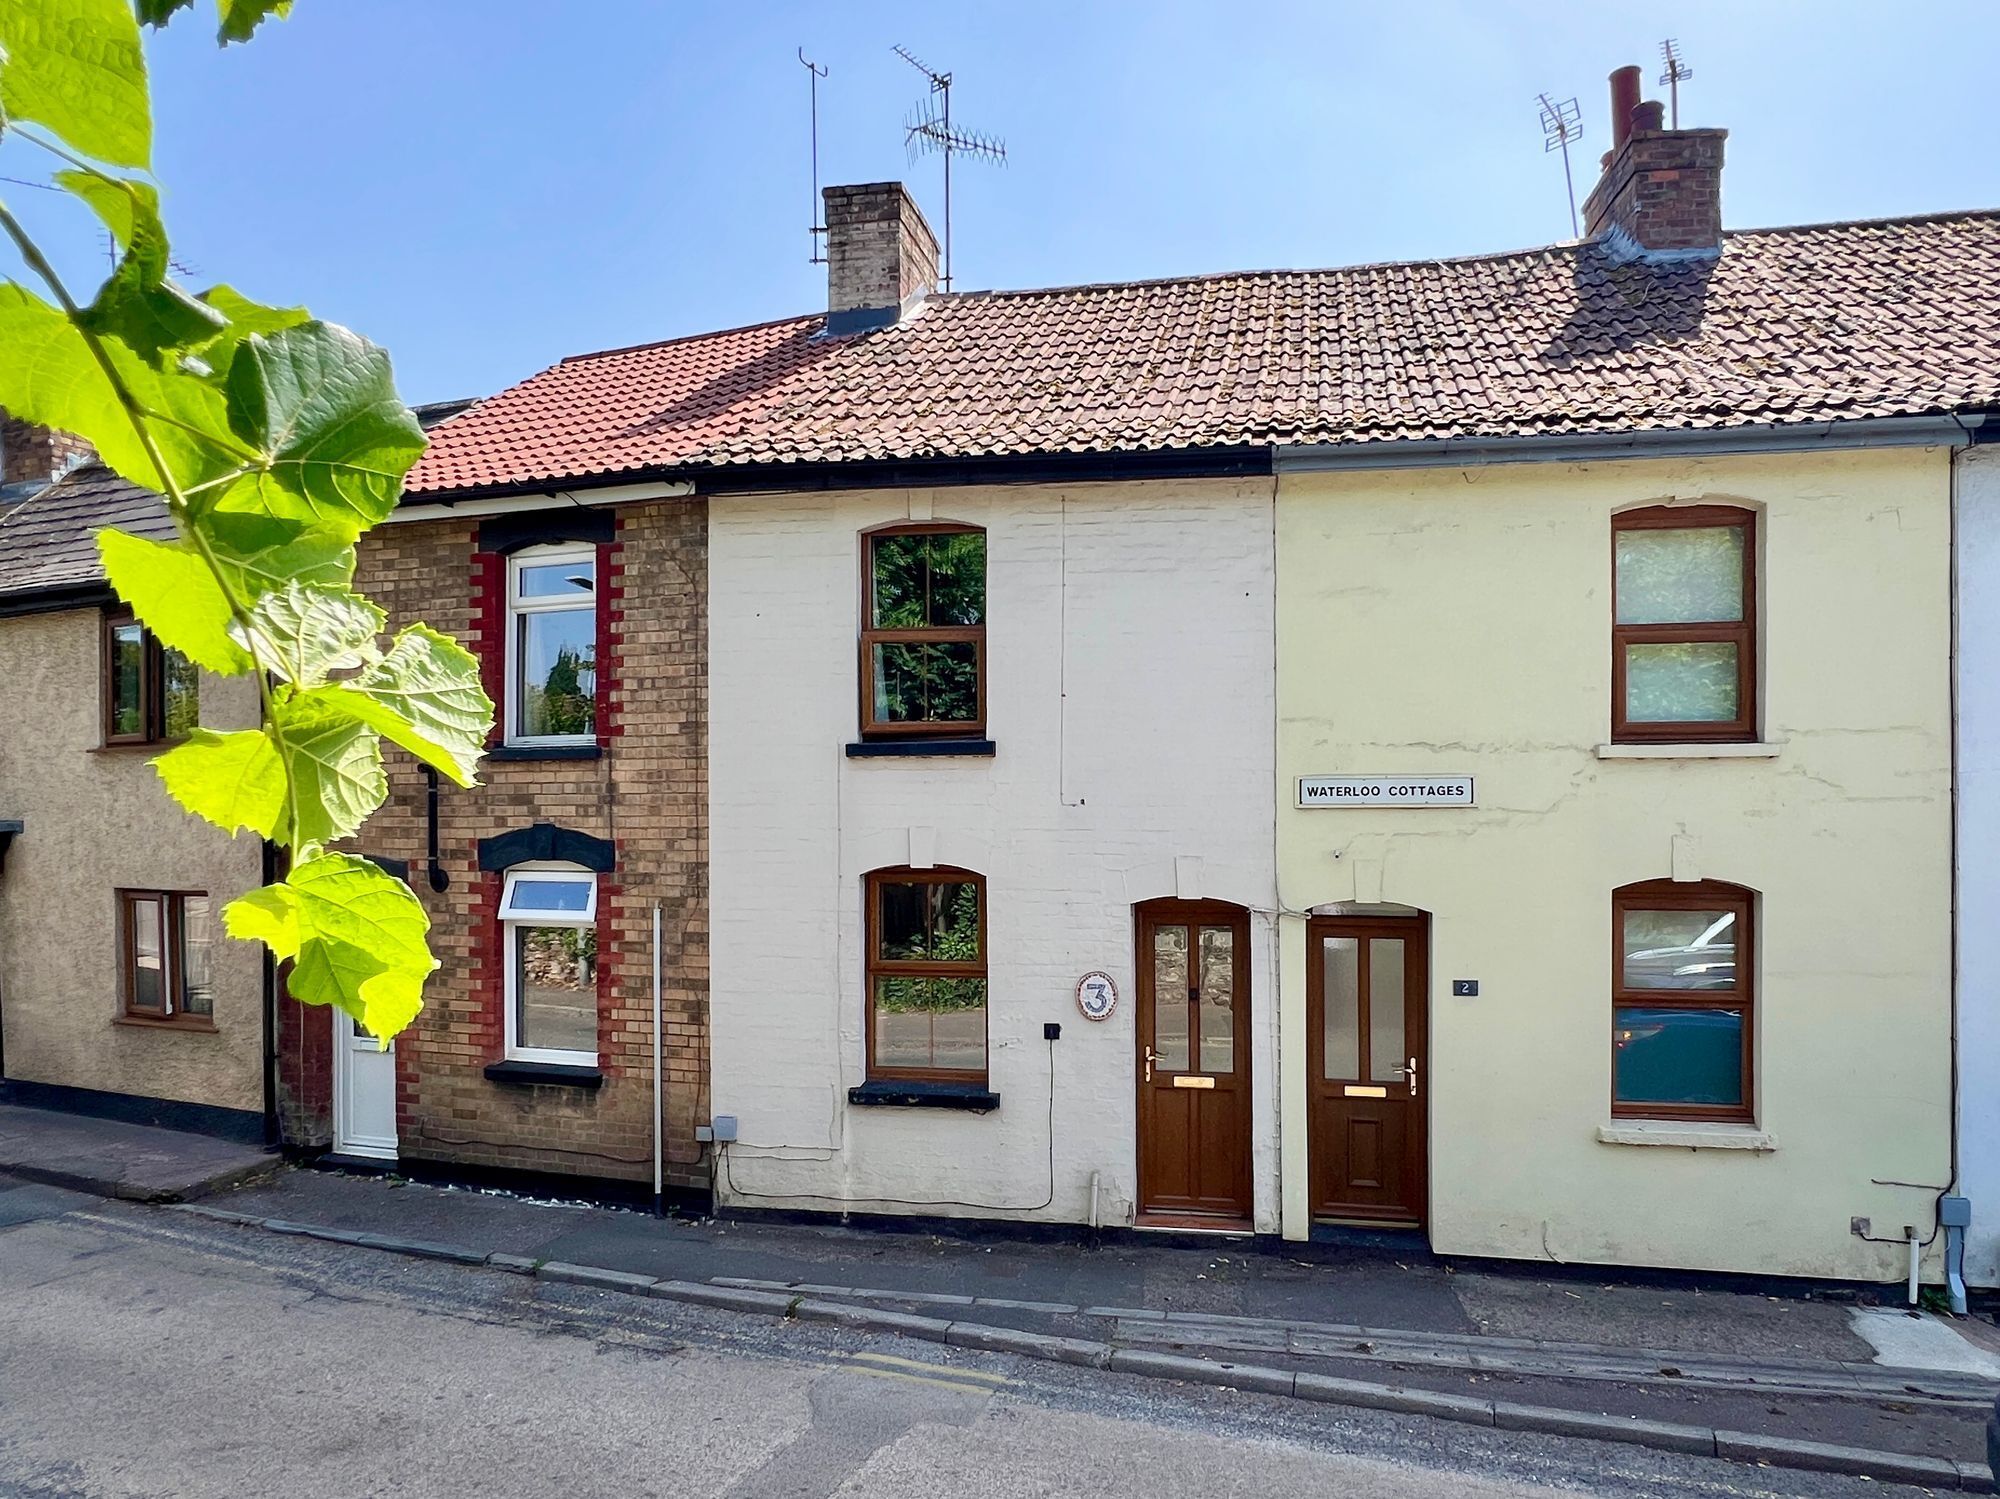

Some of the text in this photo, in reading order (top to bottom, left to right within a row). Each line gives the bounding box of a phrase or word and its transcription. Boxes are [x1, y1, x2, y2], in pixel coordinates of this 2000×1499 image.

[1307, 785, 1465, 797] WATERLOO COTTAGES
[1461, 982, 1469, 993] 2
[1085, 983, 1107, 1013] 3
